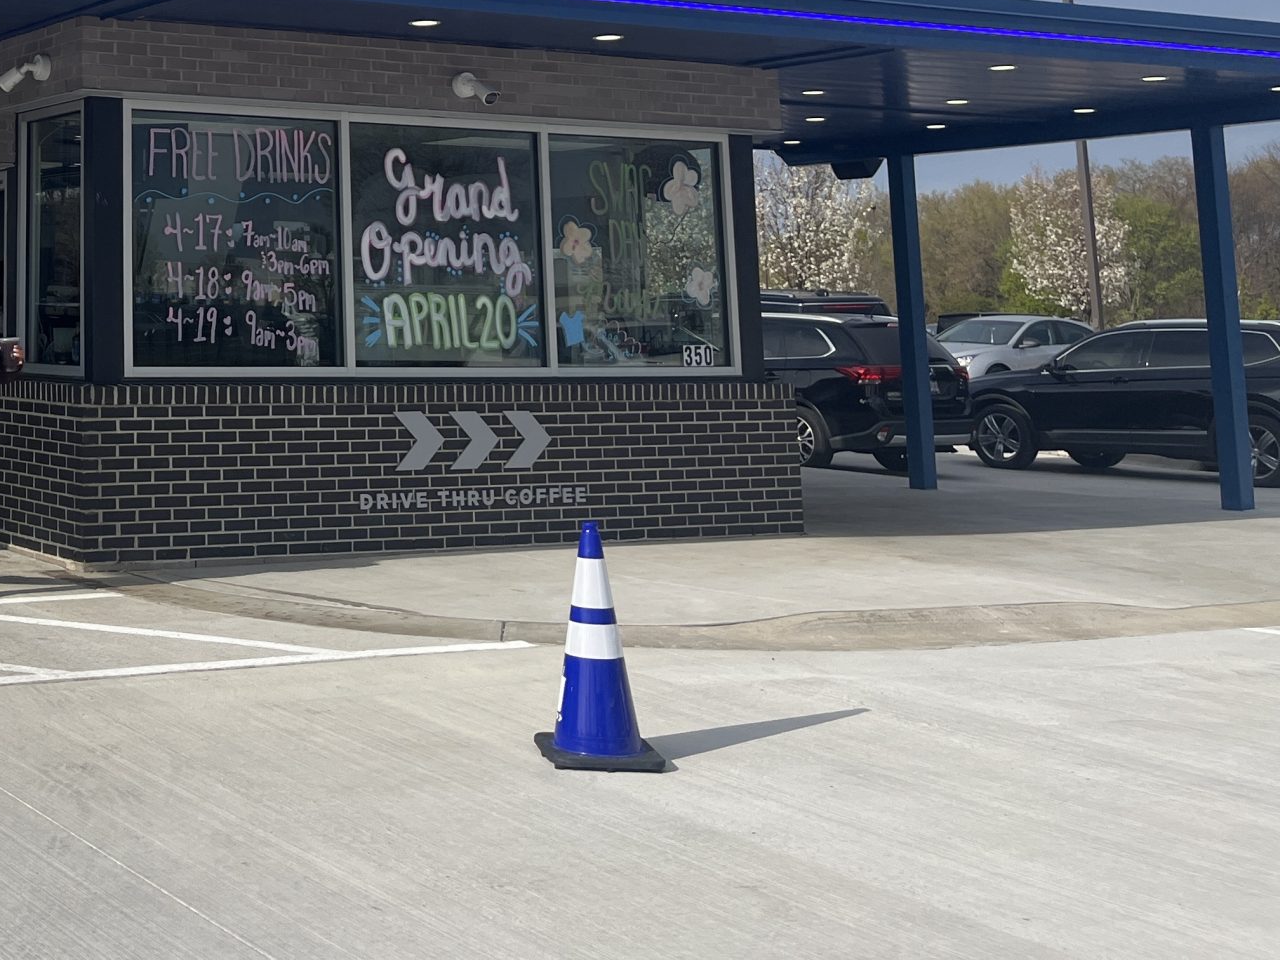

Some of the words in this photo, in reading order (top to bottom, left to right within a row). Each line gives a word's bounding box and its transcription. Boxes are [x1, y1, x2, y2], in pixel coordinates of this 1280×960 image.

[148, 127, 219, 181] FREE
[232, 127, 332, 185] DRINKS
[383, 293, 479, 351] APRIL
[684, 345, 713, 366] 350
[359, 492, 428, 511] DRIVE
[437, 489, 496, 507] THRU
[504, 486, 588, 506] COFFEE
